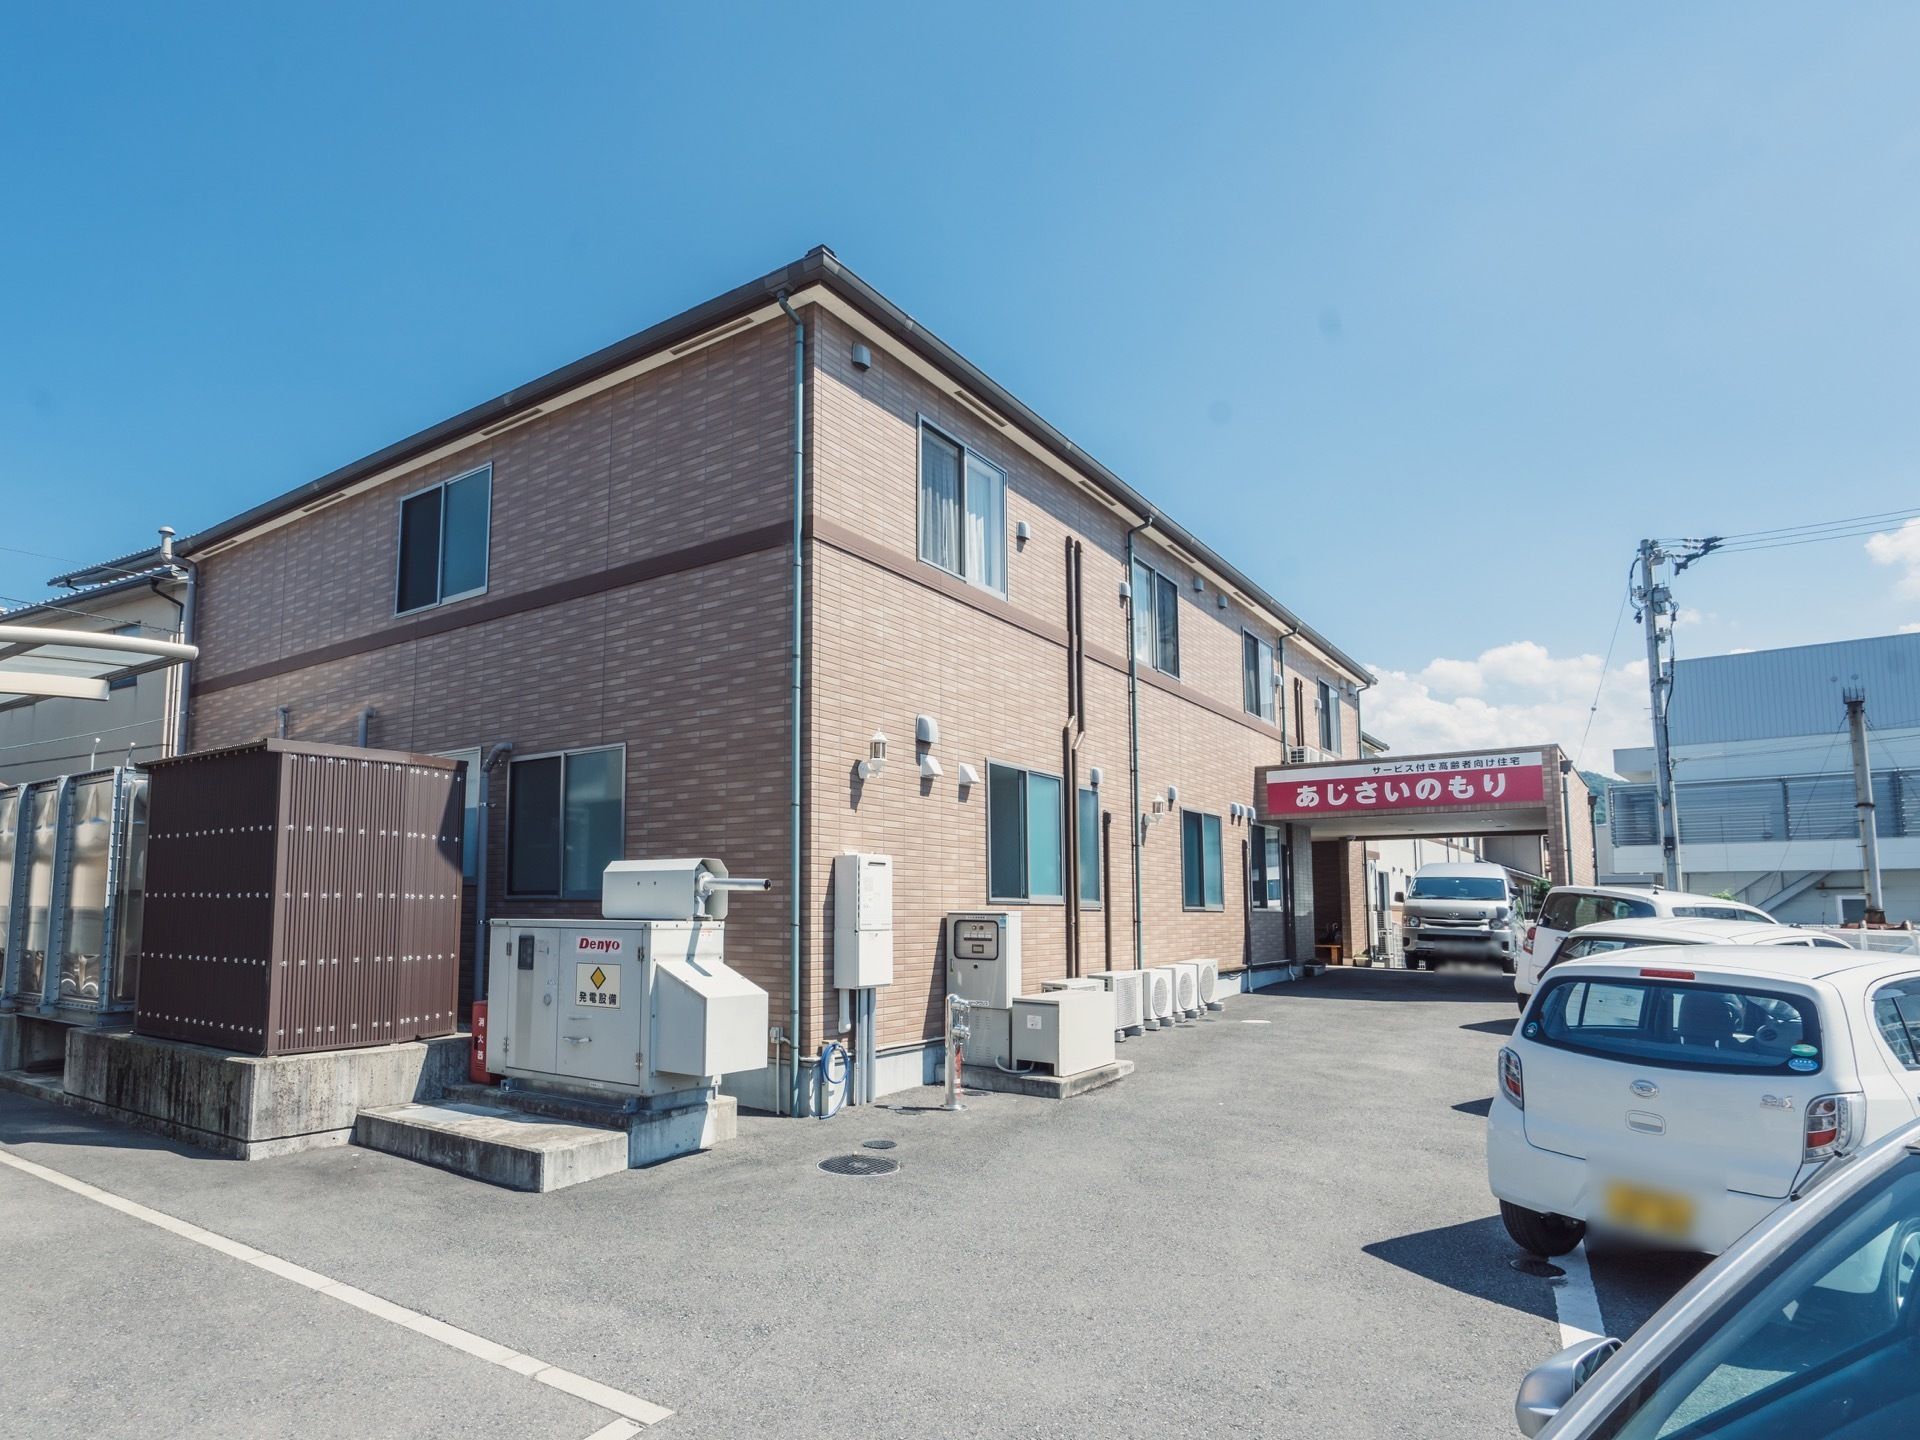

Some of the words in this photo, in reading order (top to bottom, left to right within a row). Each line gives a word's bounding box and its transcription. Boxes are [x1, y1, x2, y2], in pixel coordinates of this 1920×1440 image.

[1372, 756, 1520, 774] サービス付き高齢者向け住宅
[1296, 773, 1506, 807] あじさいのもり
[579, 938, 620, 953] Denyo
[579, 991, 617, 1005] 発電設備
